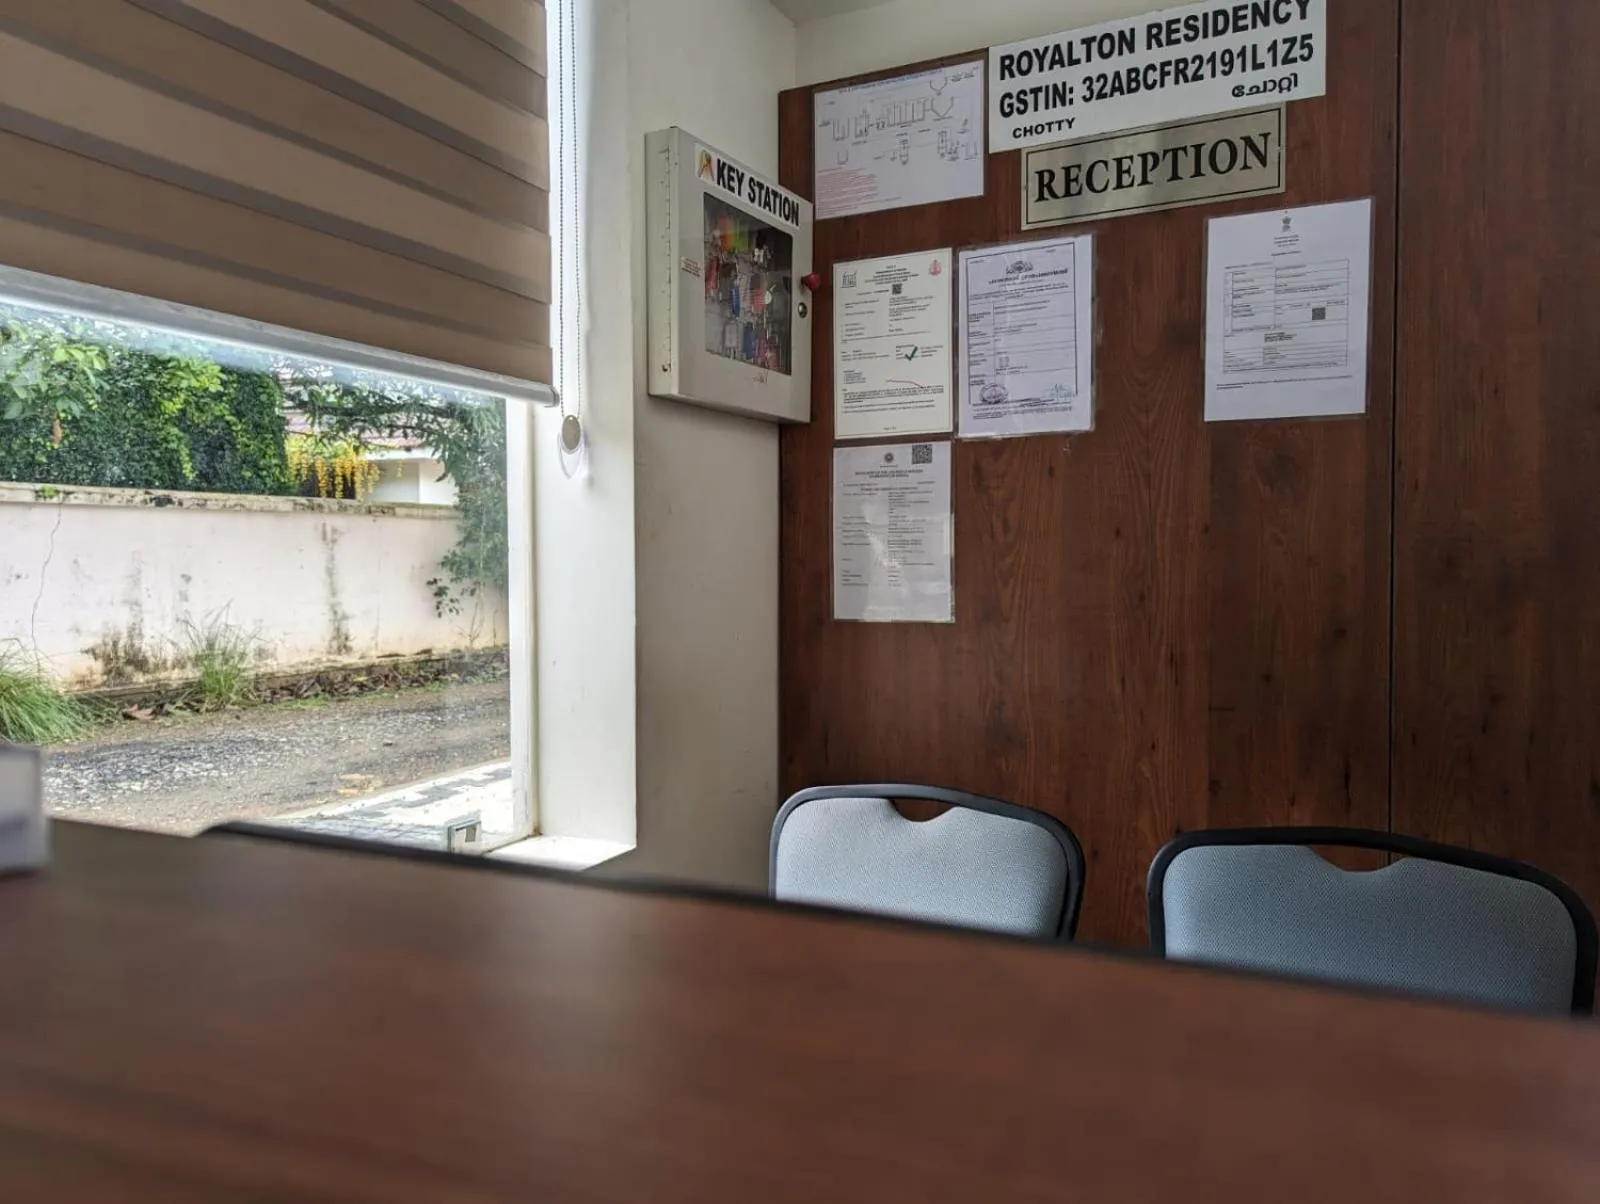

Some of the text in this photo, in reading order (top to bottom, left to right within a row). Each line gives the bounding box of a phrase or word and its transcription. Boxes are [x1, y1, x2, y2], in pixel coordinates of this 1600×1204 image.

[999, 0, 1312, 81] ROYALTON RESIDENCY
[999, 80, 1075, 118] GSTIN:
[1081, 33, 1314, 103] 32ABCFR2191L1Z5
[1012, 117, 1076, 139] CHOTTY
[716, 158, 745, 197] KEY
[748, 180, 800, 227] STATION
[1034, 132, 1271, 202] RECEPTION
